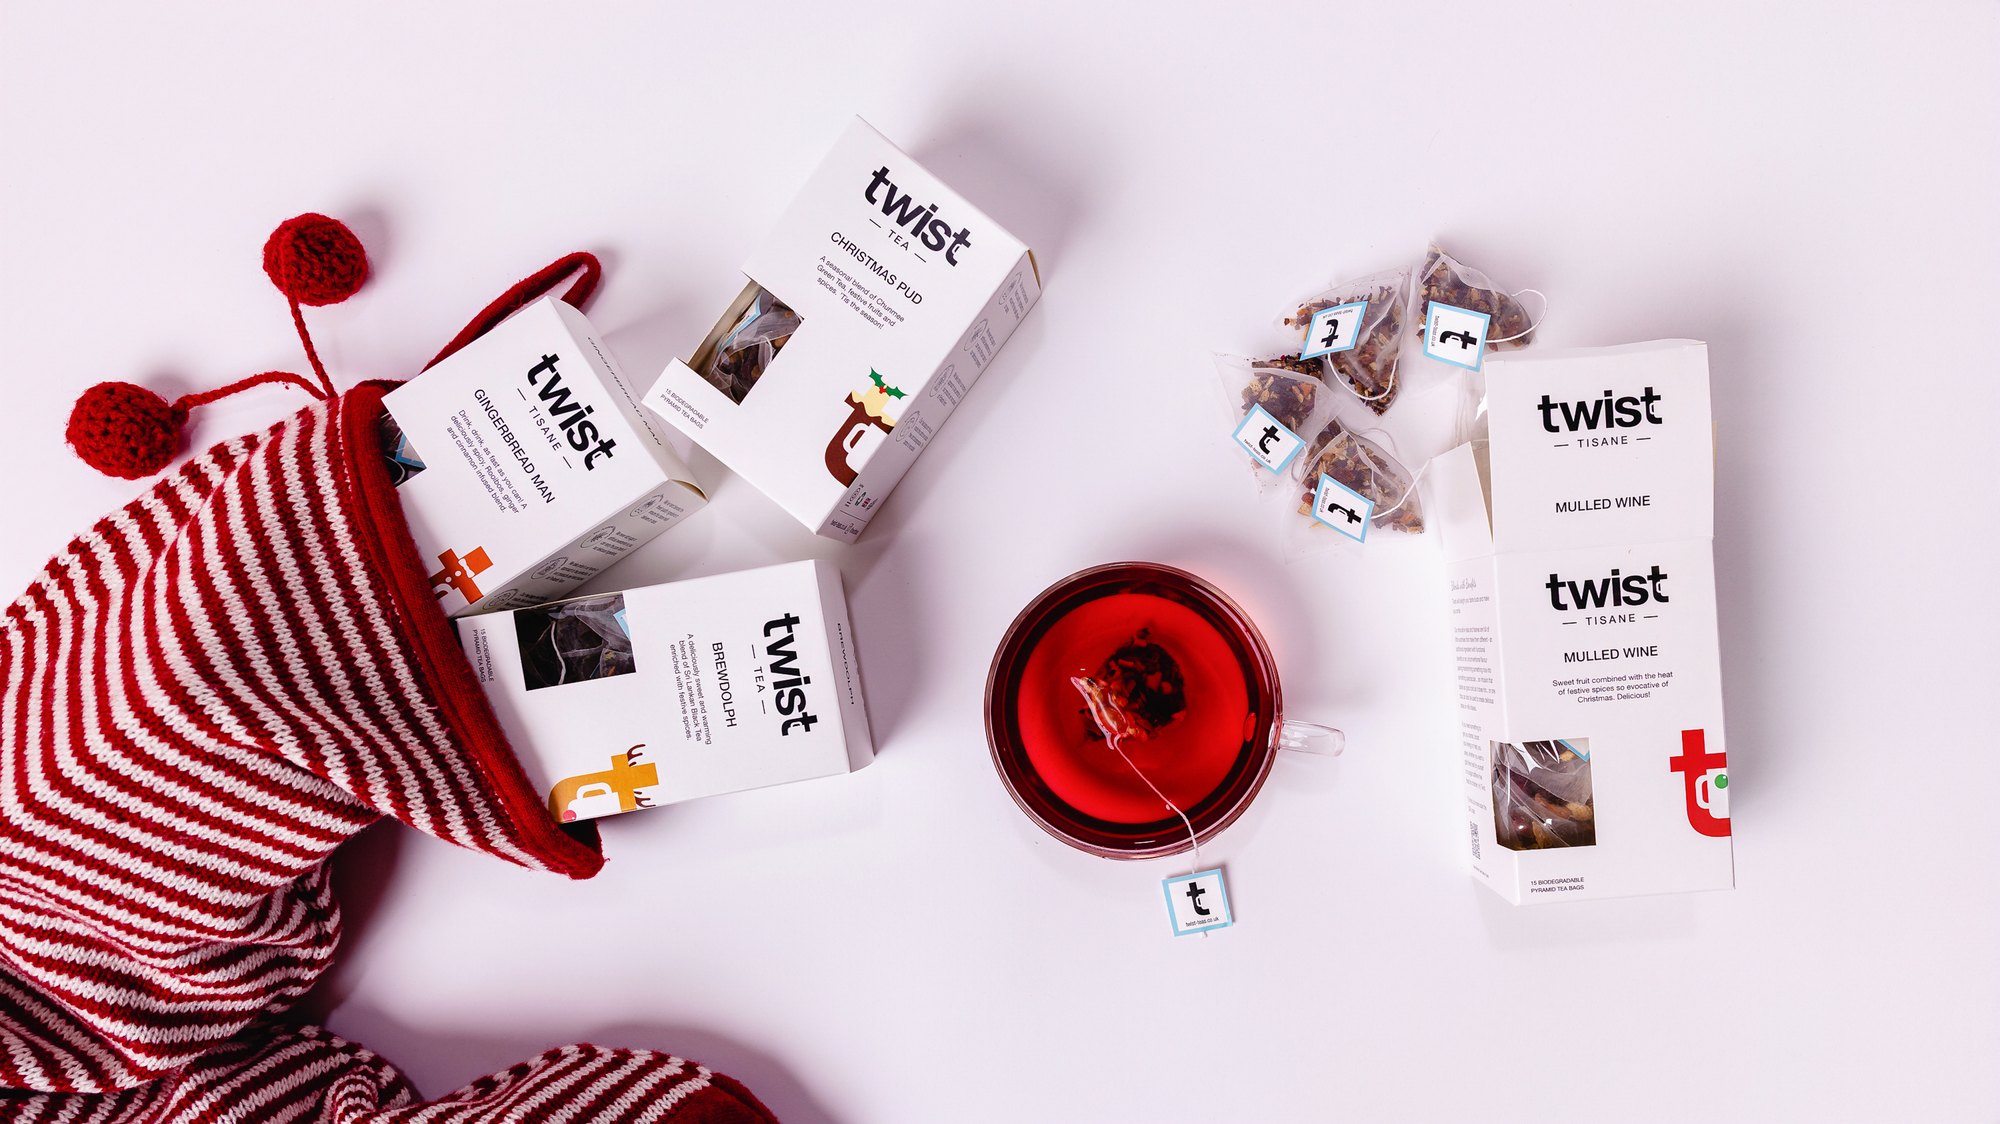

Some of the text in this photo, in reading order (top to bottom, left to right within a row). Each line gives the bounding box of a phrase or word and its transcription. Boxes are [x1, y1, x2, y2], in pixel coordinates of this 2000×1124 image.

[865, 166, 971, 267] twist
[888, 229, 909, 251] TEA
[831, 232, 922, 304] CHRISTMAS PUD
[817, 264, 896, 326] Green Tea, festive fruits and
[817, 277, 837, 295] spices.
[850, 301, 860, 312] the
[860, 310, 884, 329] season!
[825, 261, 853, 282] seasonal
[852, 279, 870, 295] blend
[876, 298, 904, 322] Chunmee
[1321, 319, 1339, 348] t
[1439, 331, 1477, 350] t
[527, 353, 616, 471] twist
[660, 394, 704, 429] PYRAMID TEA BAGS
[671, 392, 709, 423] BIODEGRADABLE
[1537, 386, 1663, 433] twist
[529, 405, 562, 451] TISANE
[1259, 425, 1280, 455] t
[1577, 435, 1628, 448] TISANE
[458, 410, 472, 429] Drink,
[471, 429, 484, 447] drink,
[483, 447, 491, 456] as
[489, 455, 500, 468] fast
[497, 468, 505, 477] as
[502, 476, 514, 489] you
[511, 489, 524, 503] can!
[474, 389, 555, 503] GINGERBREAD MAN
[447, 427, 507, 513] and cinnamon infused blend.
[451, 416, 519, 513] deliciously spicy, Rooibos, ginger
[1328, 503, 1362, 524] t
[1555, 495, 1651, 513] MULLED WINE
[1545, 565, 1669, 611] twist
[1585, 613, 1636, 626] TISANE
[473, 629, 481, 655] PYRAMID
[679, 640, 688, 660] blend
[1564, 646, 1658, 663] MULLED WINE
[482, 636, 495, 683] BIODEGRADABLE
[670, 644, 681, 674] enriched
[688, 640, 700, 676] deliciously
[684, 670, 692, 680] Sri
[695, 678, 704, 699] sweet
[712, 642, 737, 727] BREWDOLPH
[754, 666, 765, 693] TEA
[763, 613, 818, 736] twist
[1552, 679, 1574, 687] Sweet
[1592, 675, 1626, 683] combined
[1567, 687, 1590, 695] festive
[1592, 686, 1614, 694] spices
[1626, 682, 1659, 690] evocative
[679, 692, 687, 714] festive
[686, 681, 695, 707] Lankan
[699, 700, 707, 714] and
[1577, 692, 1650, 703] Christmas. Delicious!
[682, 716, 692, 740] spices.
[691, 708, 700, 728] Black
[701, 715, 712, 745] warming
[1538, 877, 1584, 885] BIODEGRADABLE
[1186, 882, 1210, 915] t
